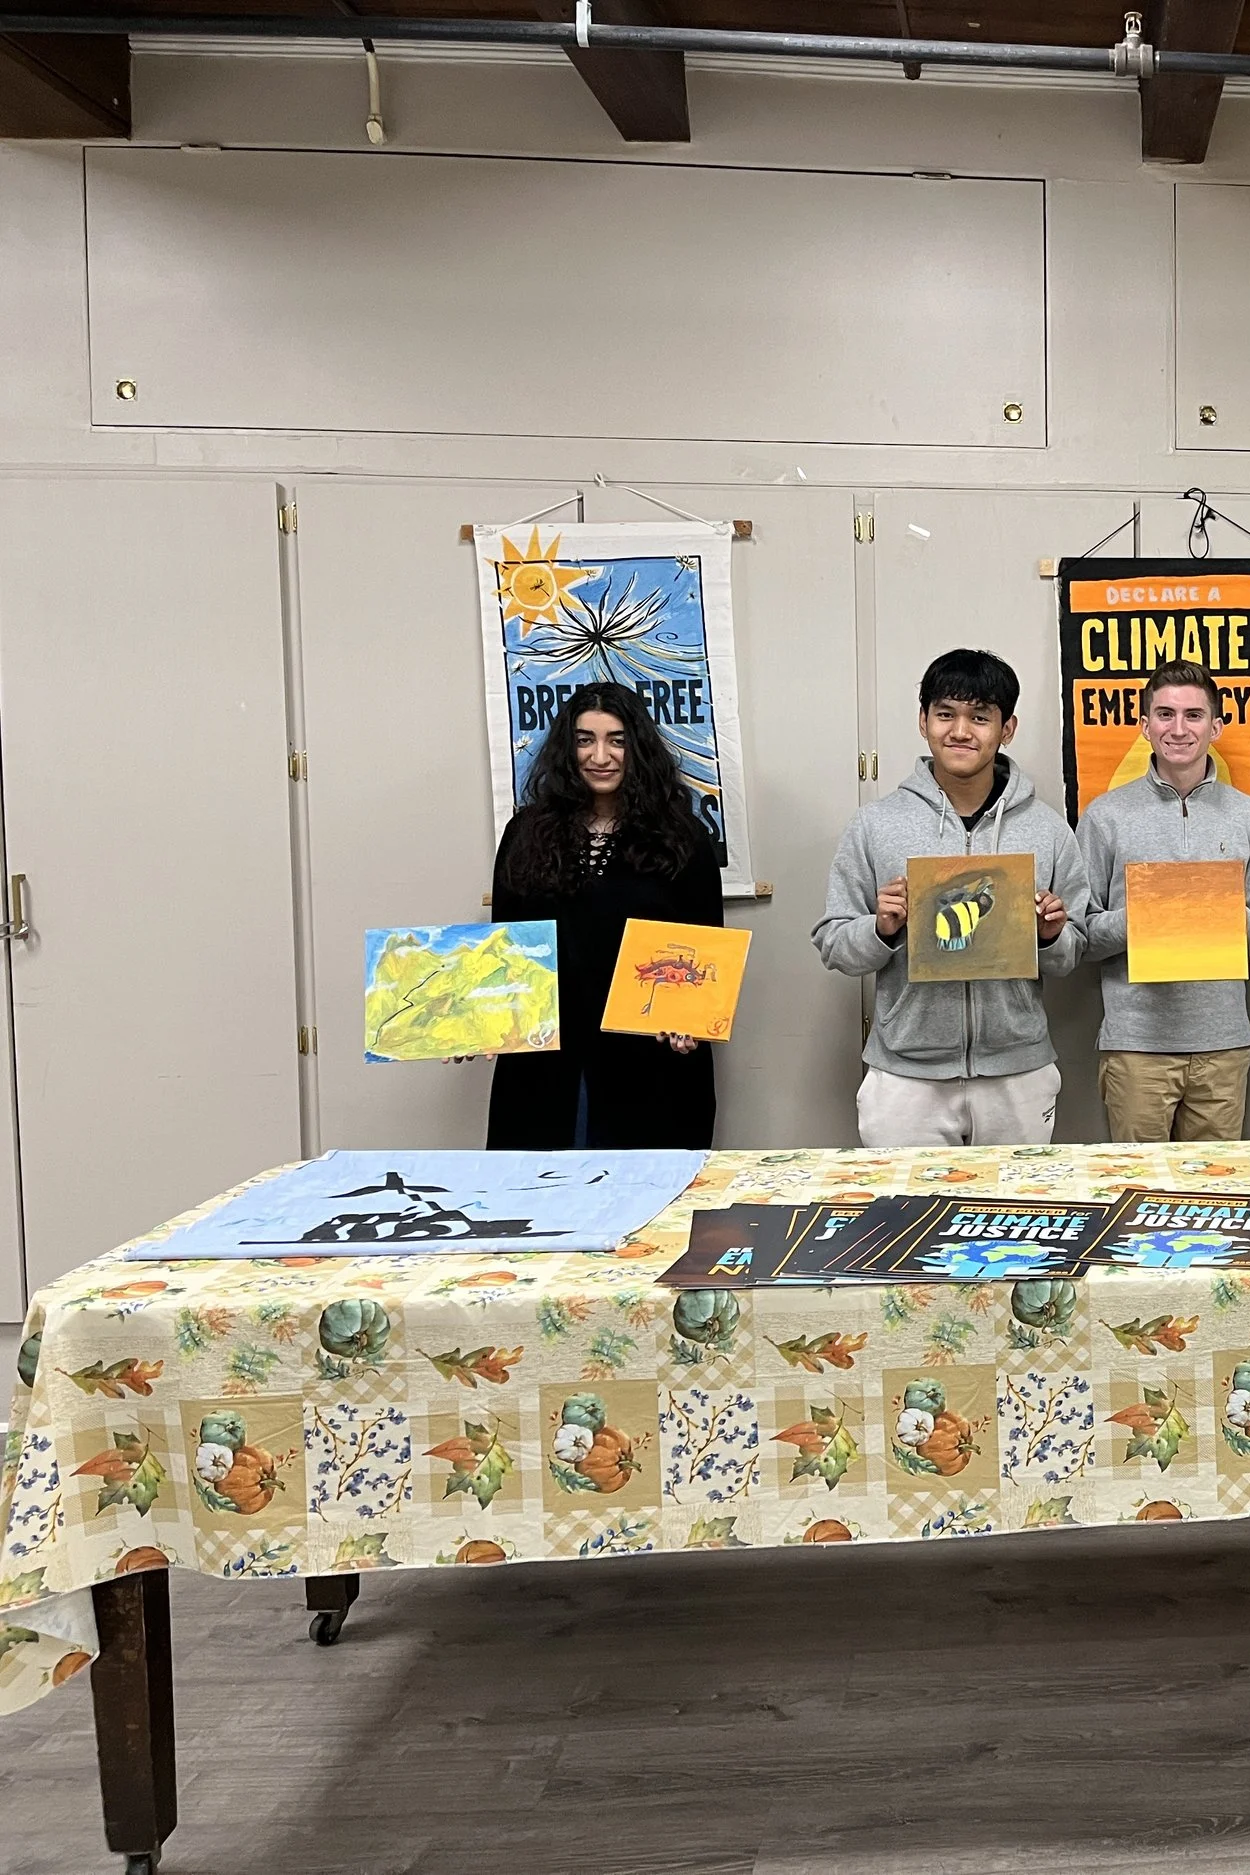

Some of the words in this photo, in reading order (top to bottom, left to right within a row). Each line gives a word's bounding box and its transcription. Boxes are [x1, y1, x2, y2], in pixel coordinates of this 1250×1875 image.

[1106, 586, 1200, 605] DECLARE
[1208, 586, 1221, 602] A
[1081, 615, 1249, 672] CLIMATE
[636, 678, 704, 725] FREE
[951, 1213, 1090, 1229] CLIMATE
[939, 1224, 1084, 1241] JUSTICE
